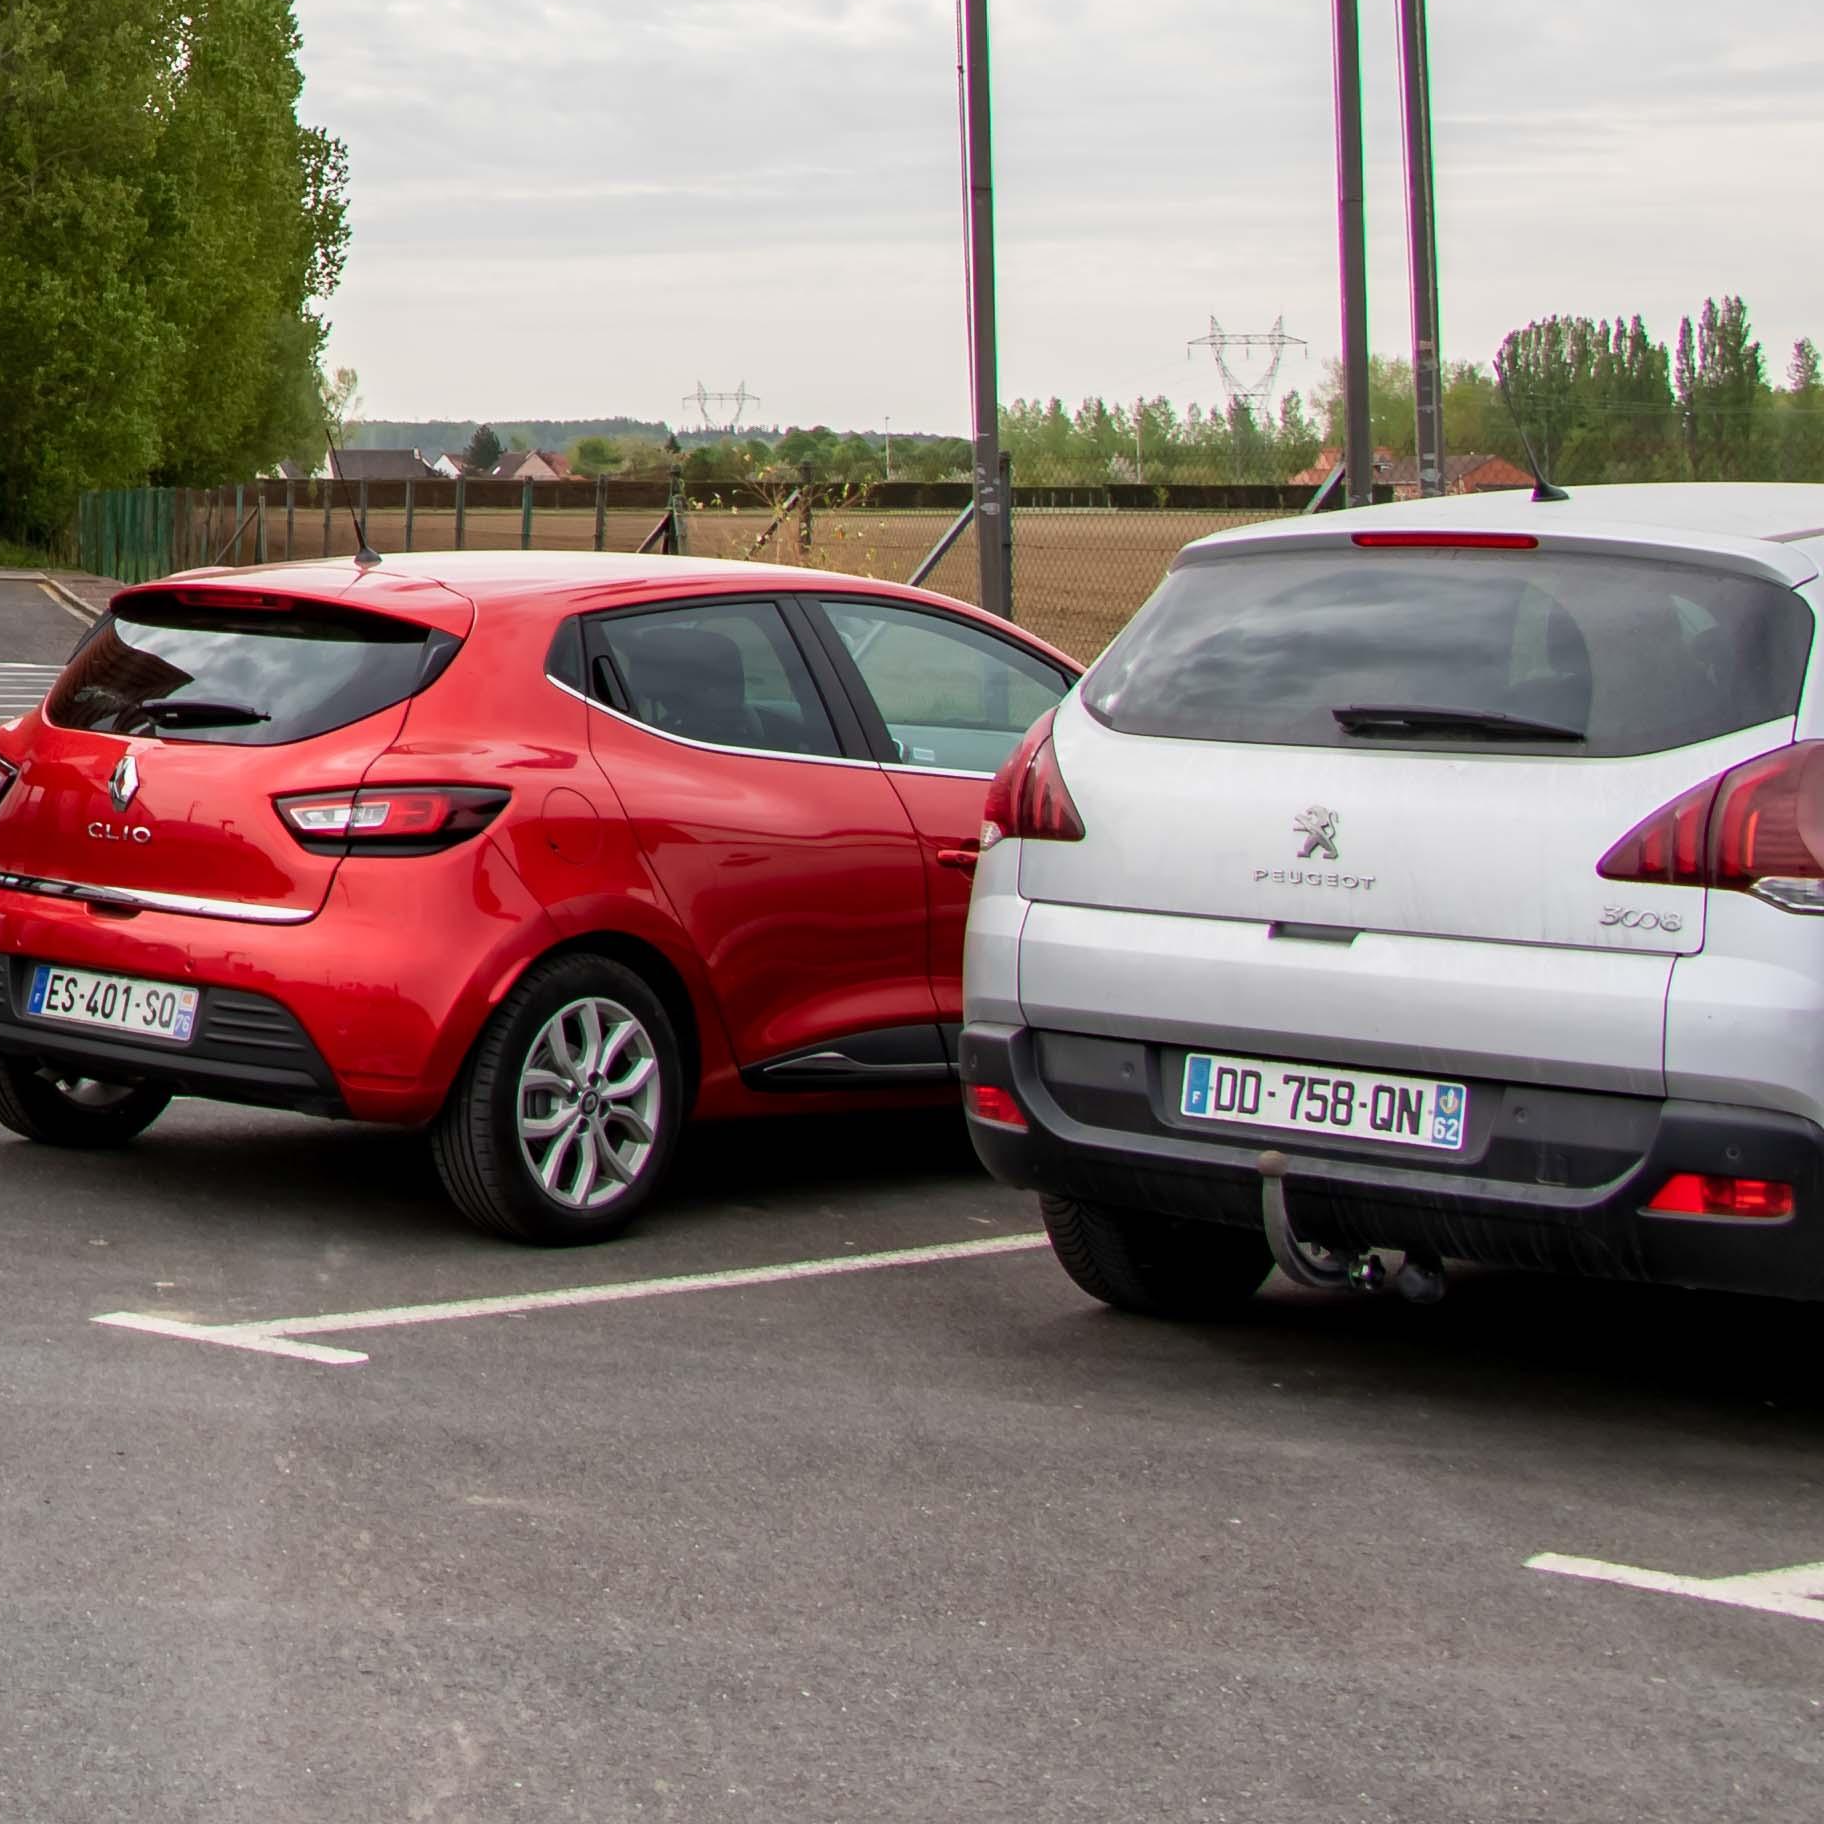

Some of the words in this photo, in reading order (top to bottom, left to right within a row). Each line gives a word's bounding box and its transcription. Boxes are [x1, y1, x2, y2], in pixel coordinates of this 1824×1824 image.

[87, 821, 151, 844] CLIO
[1253, 868, 1377, 890] PEUGEOT
[1599, 905, 1683, 933] 3008
[45, 974, 177, 1028] ES-401-SQ
[177, 1013, 192, 1033] 76
[1191, 1090, 1201, 1105] F
[1214, 1066, 1423, 1136] DD-758-QN
[1433, 1117, 1459, 1142] 62
